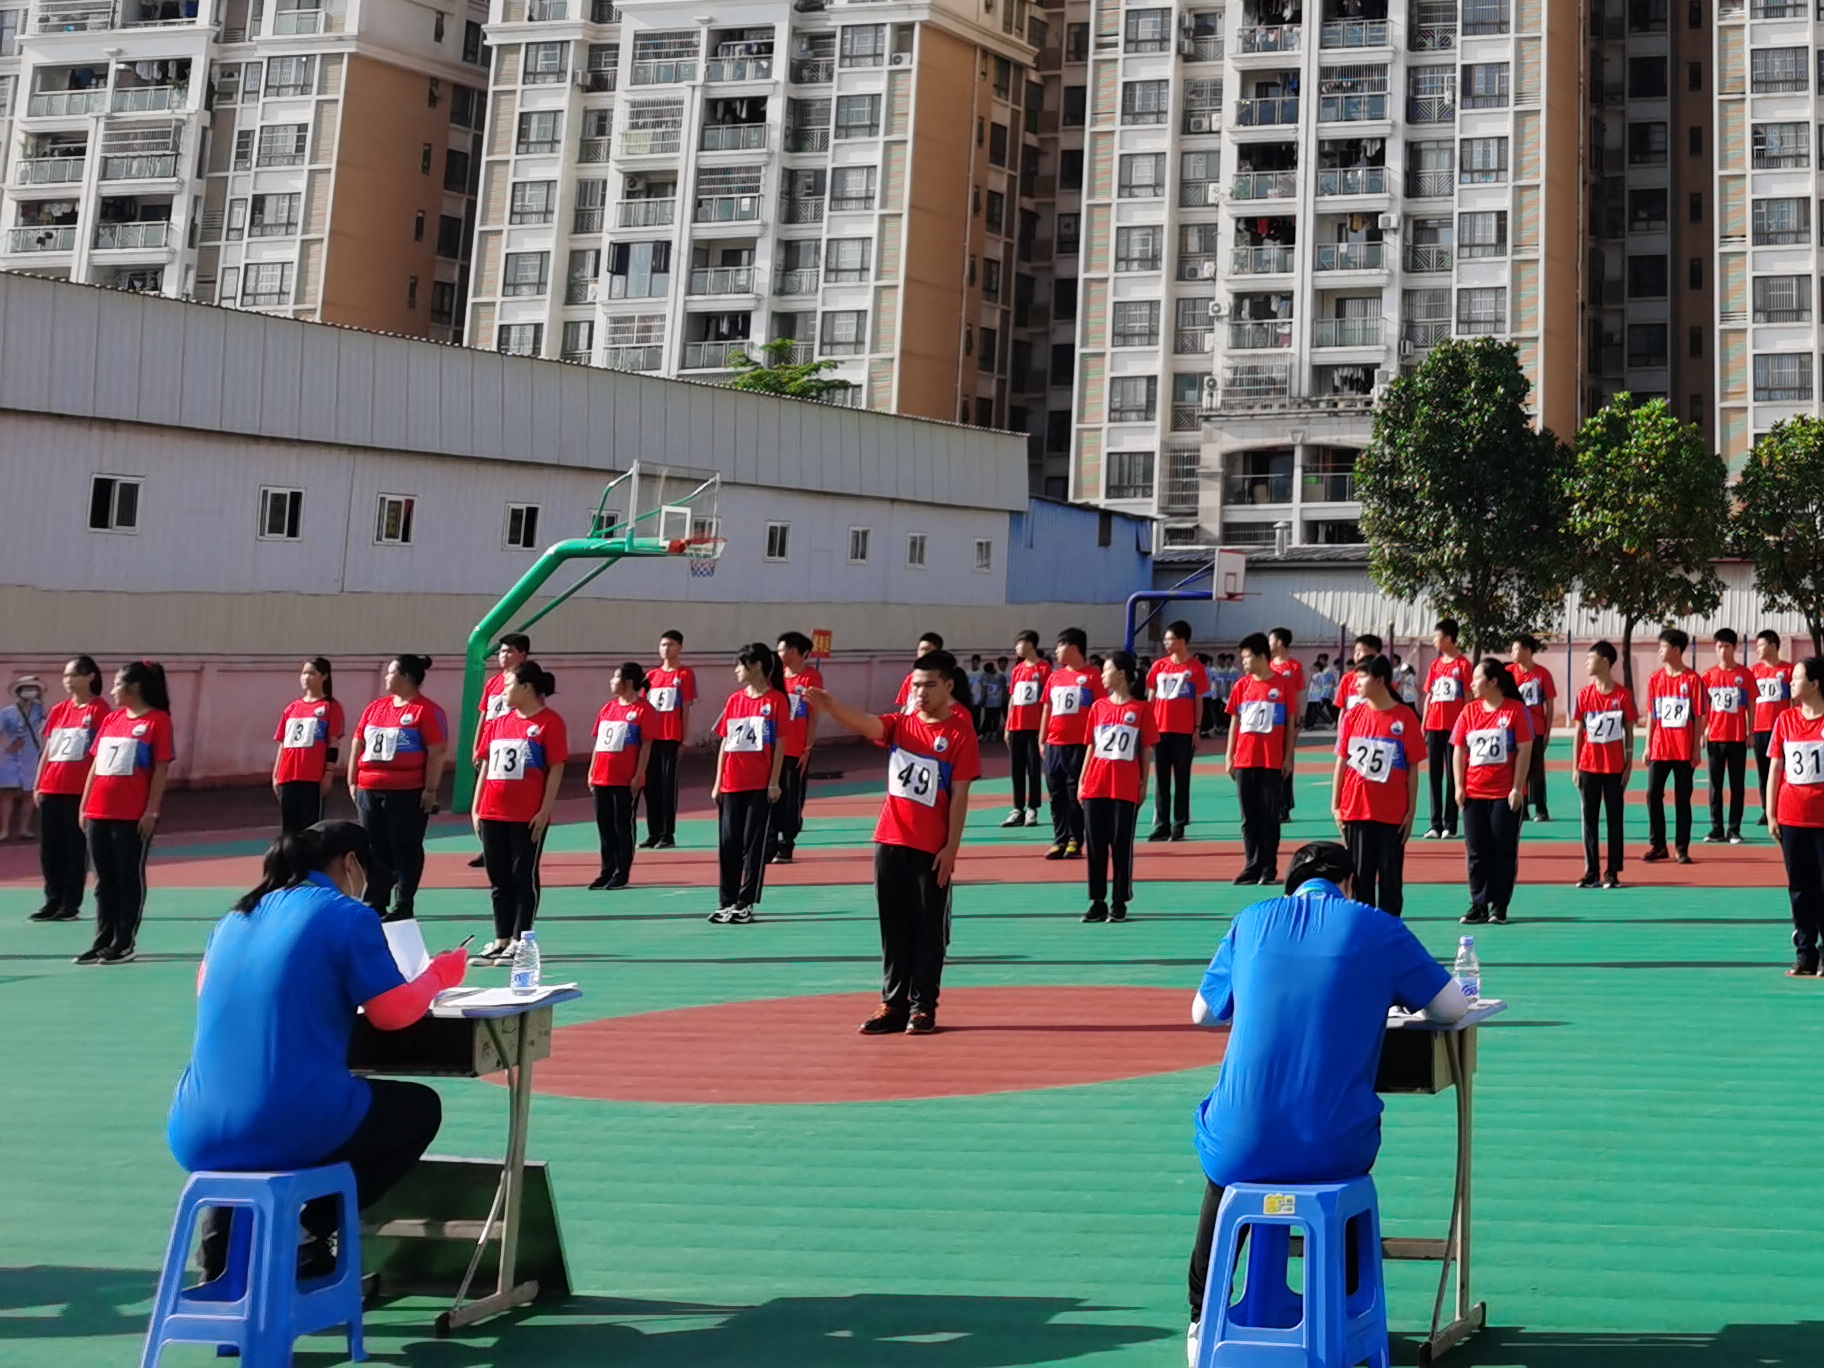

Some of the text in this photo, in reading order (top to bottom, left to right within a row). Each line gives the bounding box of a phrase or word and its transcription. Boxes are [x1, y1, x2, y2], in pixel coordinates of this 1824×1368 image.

[1019, 686, 1033, 701] 12
[1162, 678, 1179, 695] 17
[1759, 683, 1776, 698] 30
[495, 700, 503, 715] 4
[658, 692, 666, 707] 5
[1057, 693, 1074, 710] 16
[1714, 692, 1732, 709] 29
[1664, 704, 1683, 720] 28
[294, 724, 304, 741] 3
[604, 727, 613, 745] 9
[736, 725, 757, 744] 14
[1594, 717, 1615, 737] 27
[61, 736, 72, 755] 2
[373, 733, 384, 753] 8
[1103, 732, 1131, 753] 20
[1476, 736, 1500, 758] 26
[110, 746, 119, 768] 7
[494, 748, 517, 772] 13
[1357, 746, 1384, 773] 25
[1792, 749, 1821, 775] 31
[897, 762, 931, 795] 49
